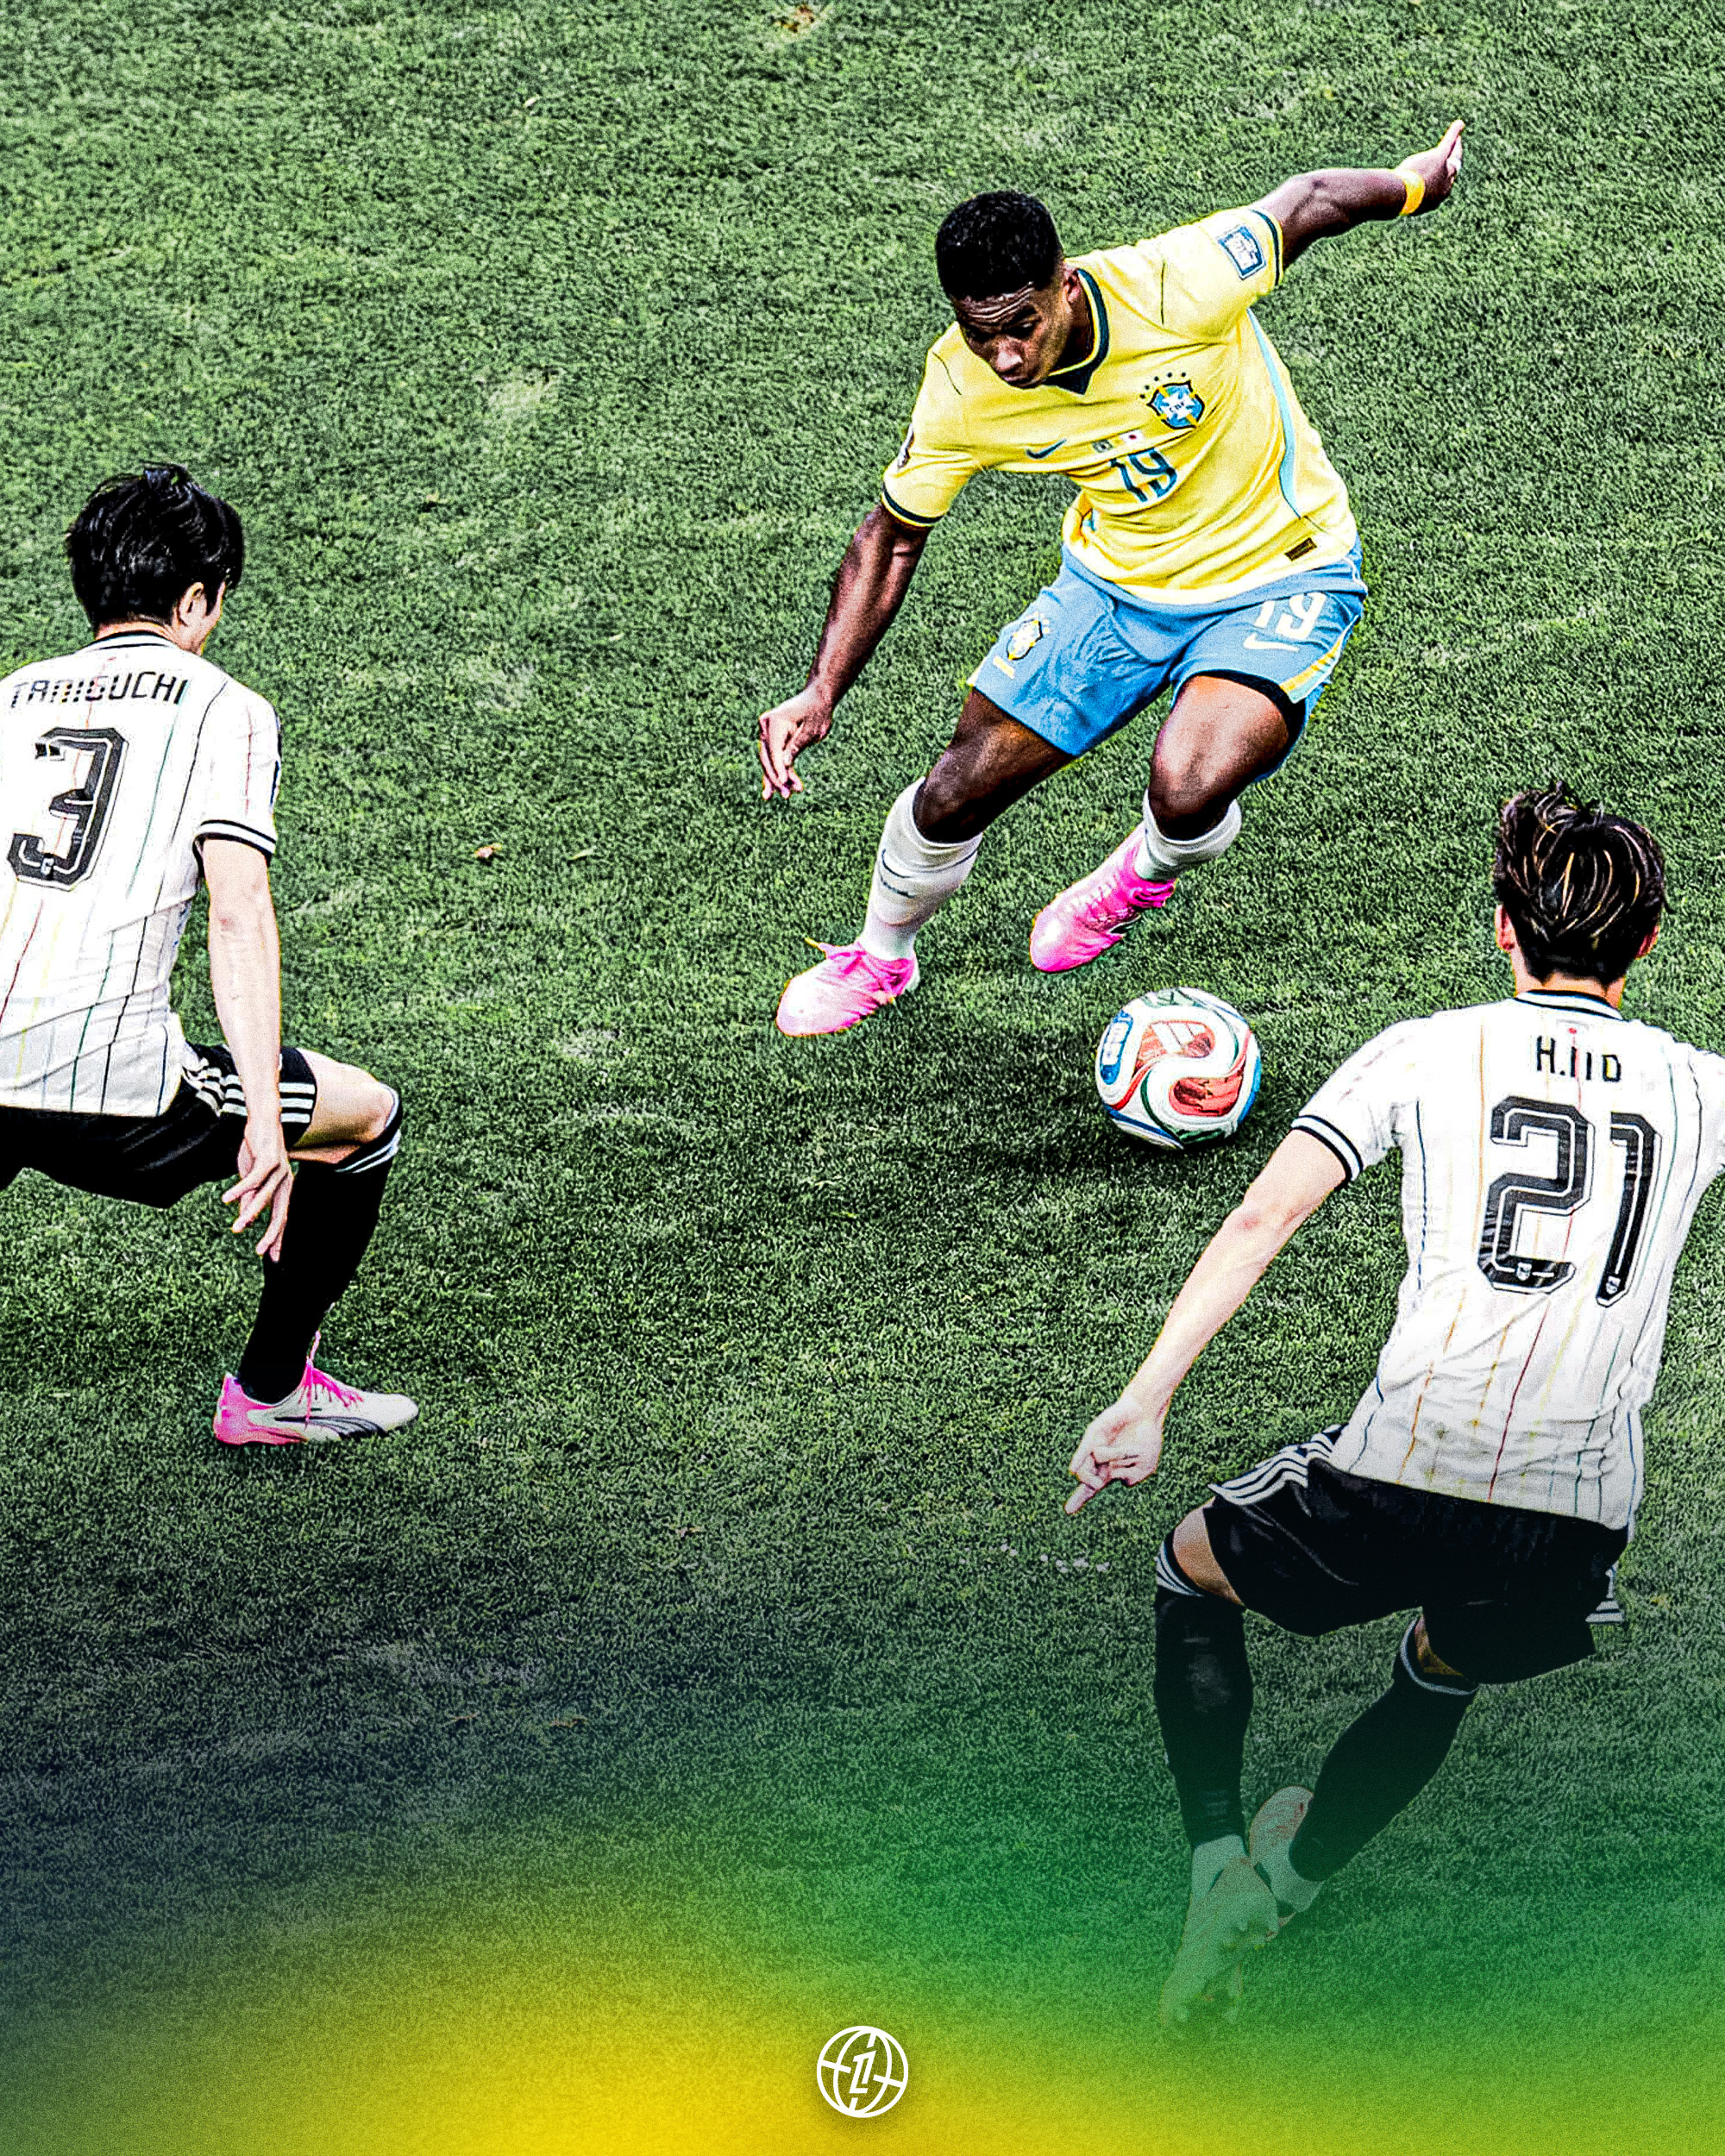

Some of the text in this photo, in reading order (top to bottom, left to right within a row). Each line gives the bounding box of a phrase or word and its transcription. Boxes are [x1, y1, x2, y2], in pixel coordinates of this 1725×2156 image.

[1109, 447, 1178, 503] 19
[1253, 591, 1327, 641] 19
[10, 671, 189, 709] TANIGUCHI
[7, 726, 129, 893] 3
[1477, 1095, 1663, 1308] 21
